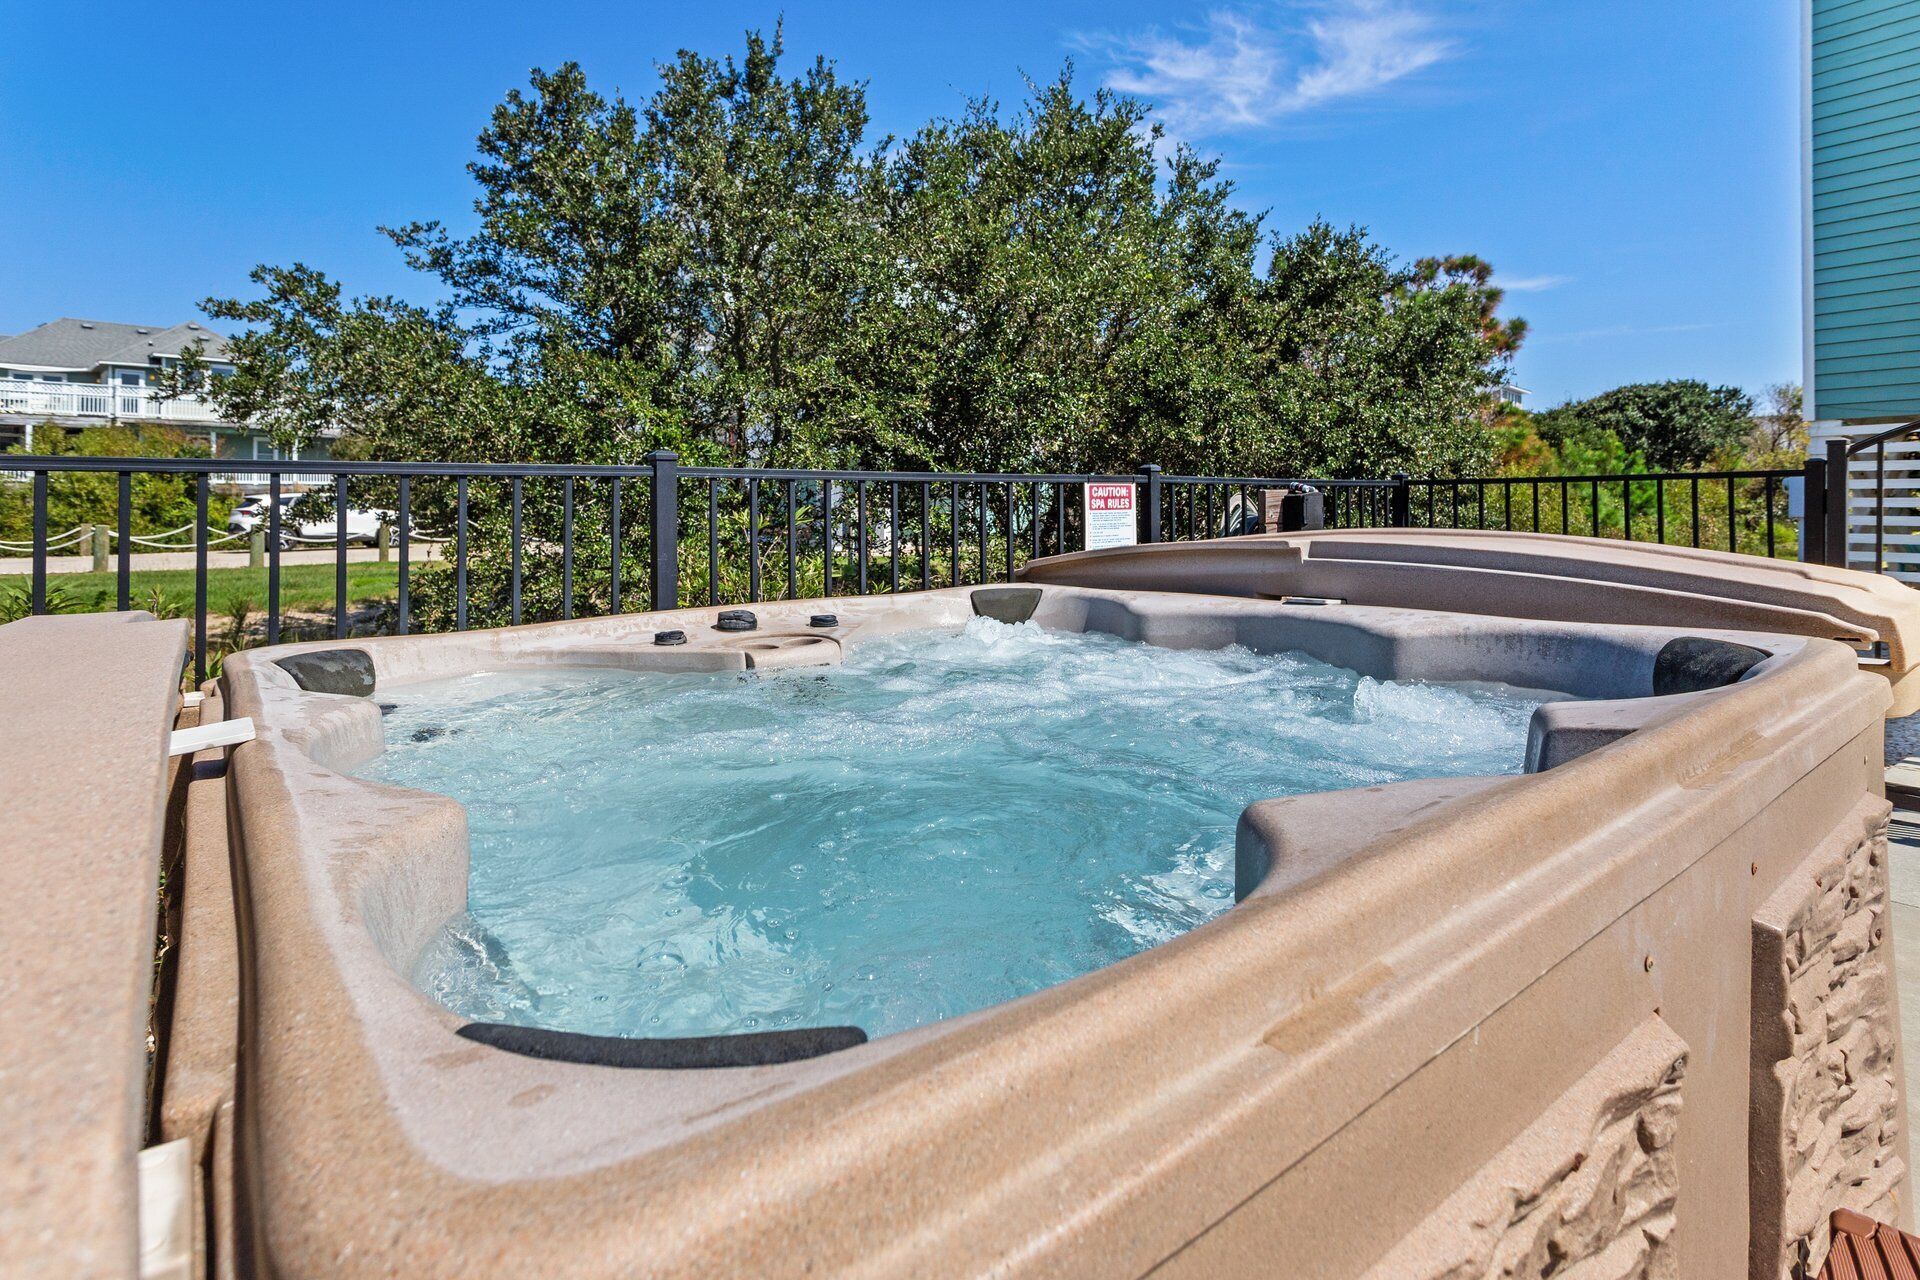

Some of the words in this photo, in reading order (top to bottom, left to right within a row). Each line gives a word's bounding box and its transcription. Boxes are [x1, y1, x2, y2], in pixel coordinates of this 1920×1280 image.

[1092, 487, 1129, 497] CAUTION:
[1091, 498, 1105, 509] SPA
[1107, 498, 1130, 508] RULES
